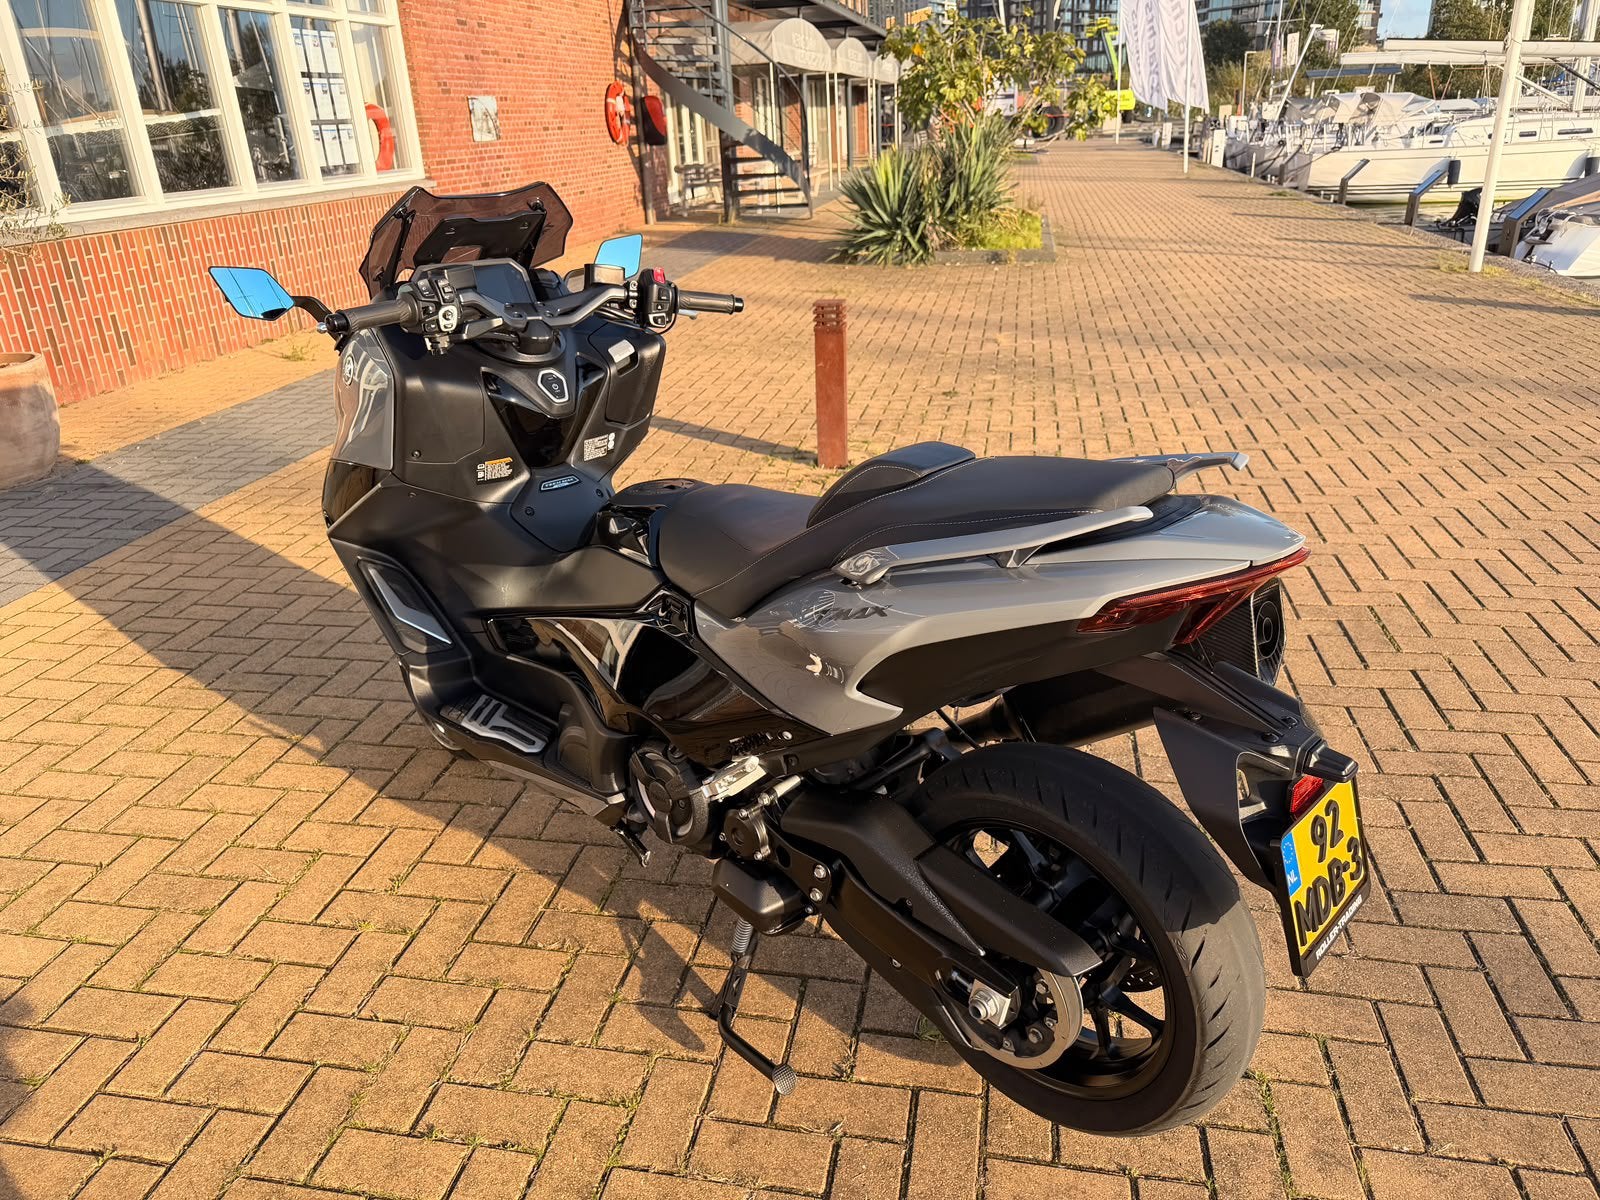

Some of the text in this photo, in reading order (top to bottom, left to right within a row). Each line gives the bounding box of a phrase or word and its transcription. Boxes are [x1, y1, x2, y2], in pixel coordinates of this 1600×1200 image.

[1310, 799, 1345, 864] 92
[1287, 869, 1298, 886] NL
[1294, 836, 1363, 947] MDB-3
[1315, 894, 1363, 960] ROLLER-TRADING
